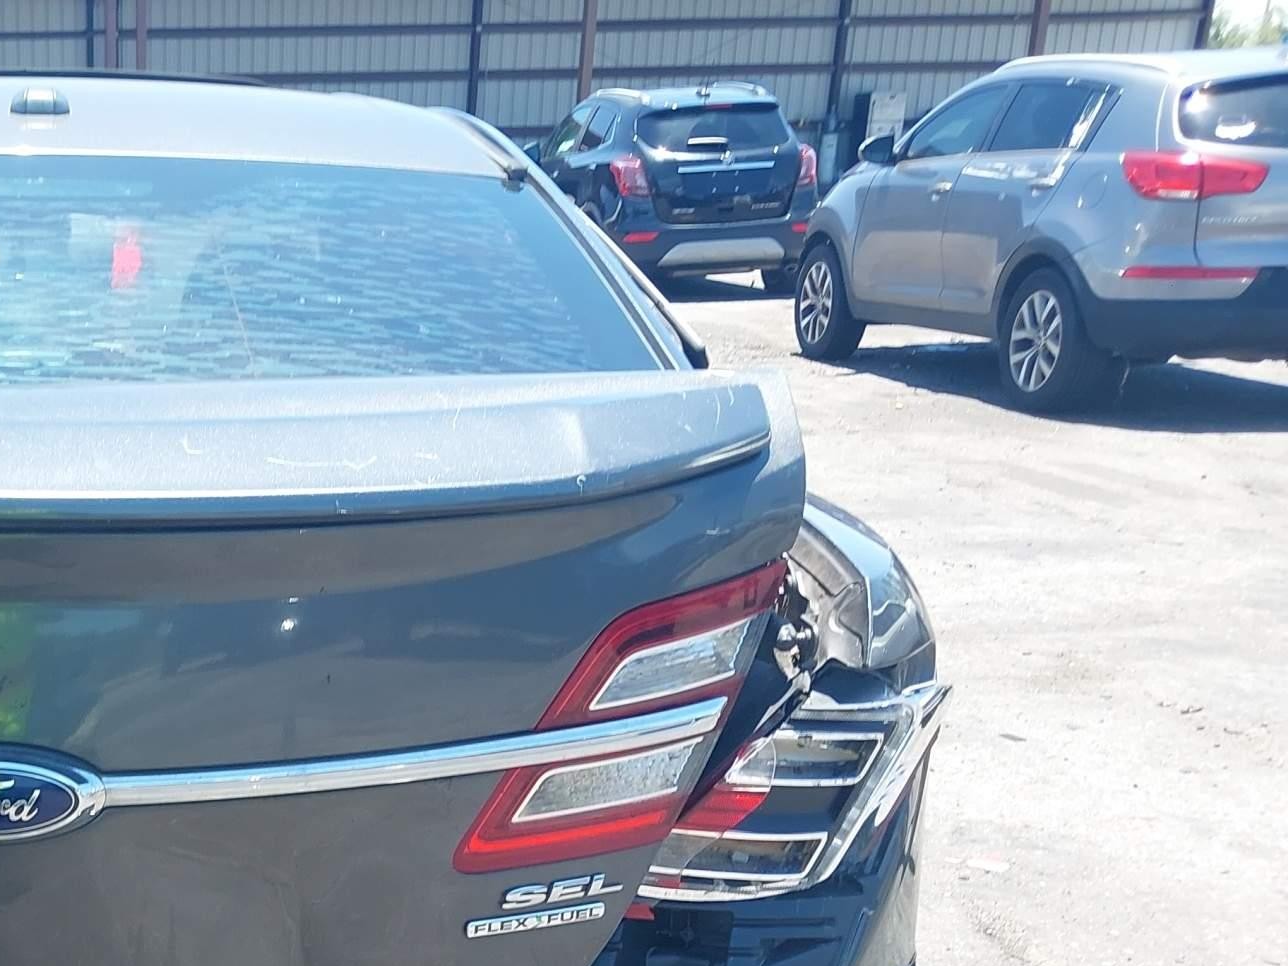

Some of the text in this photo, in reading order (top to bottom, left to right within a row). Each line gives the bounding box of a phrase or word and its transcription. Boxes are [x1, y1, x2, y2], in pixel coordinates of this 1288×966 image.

[502, 873, 624, 910] SEL
[473, 907, 601, 935] FLEX FUEL
